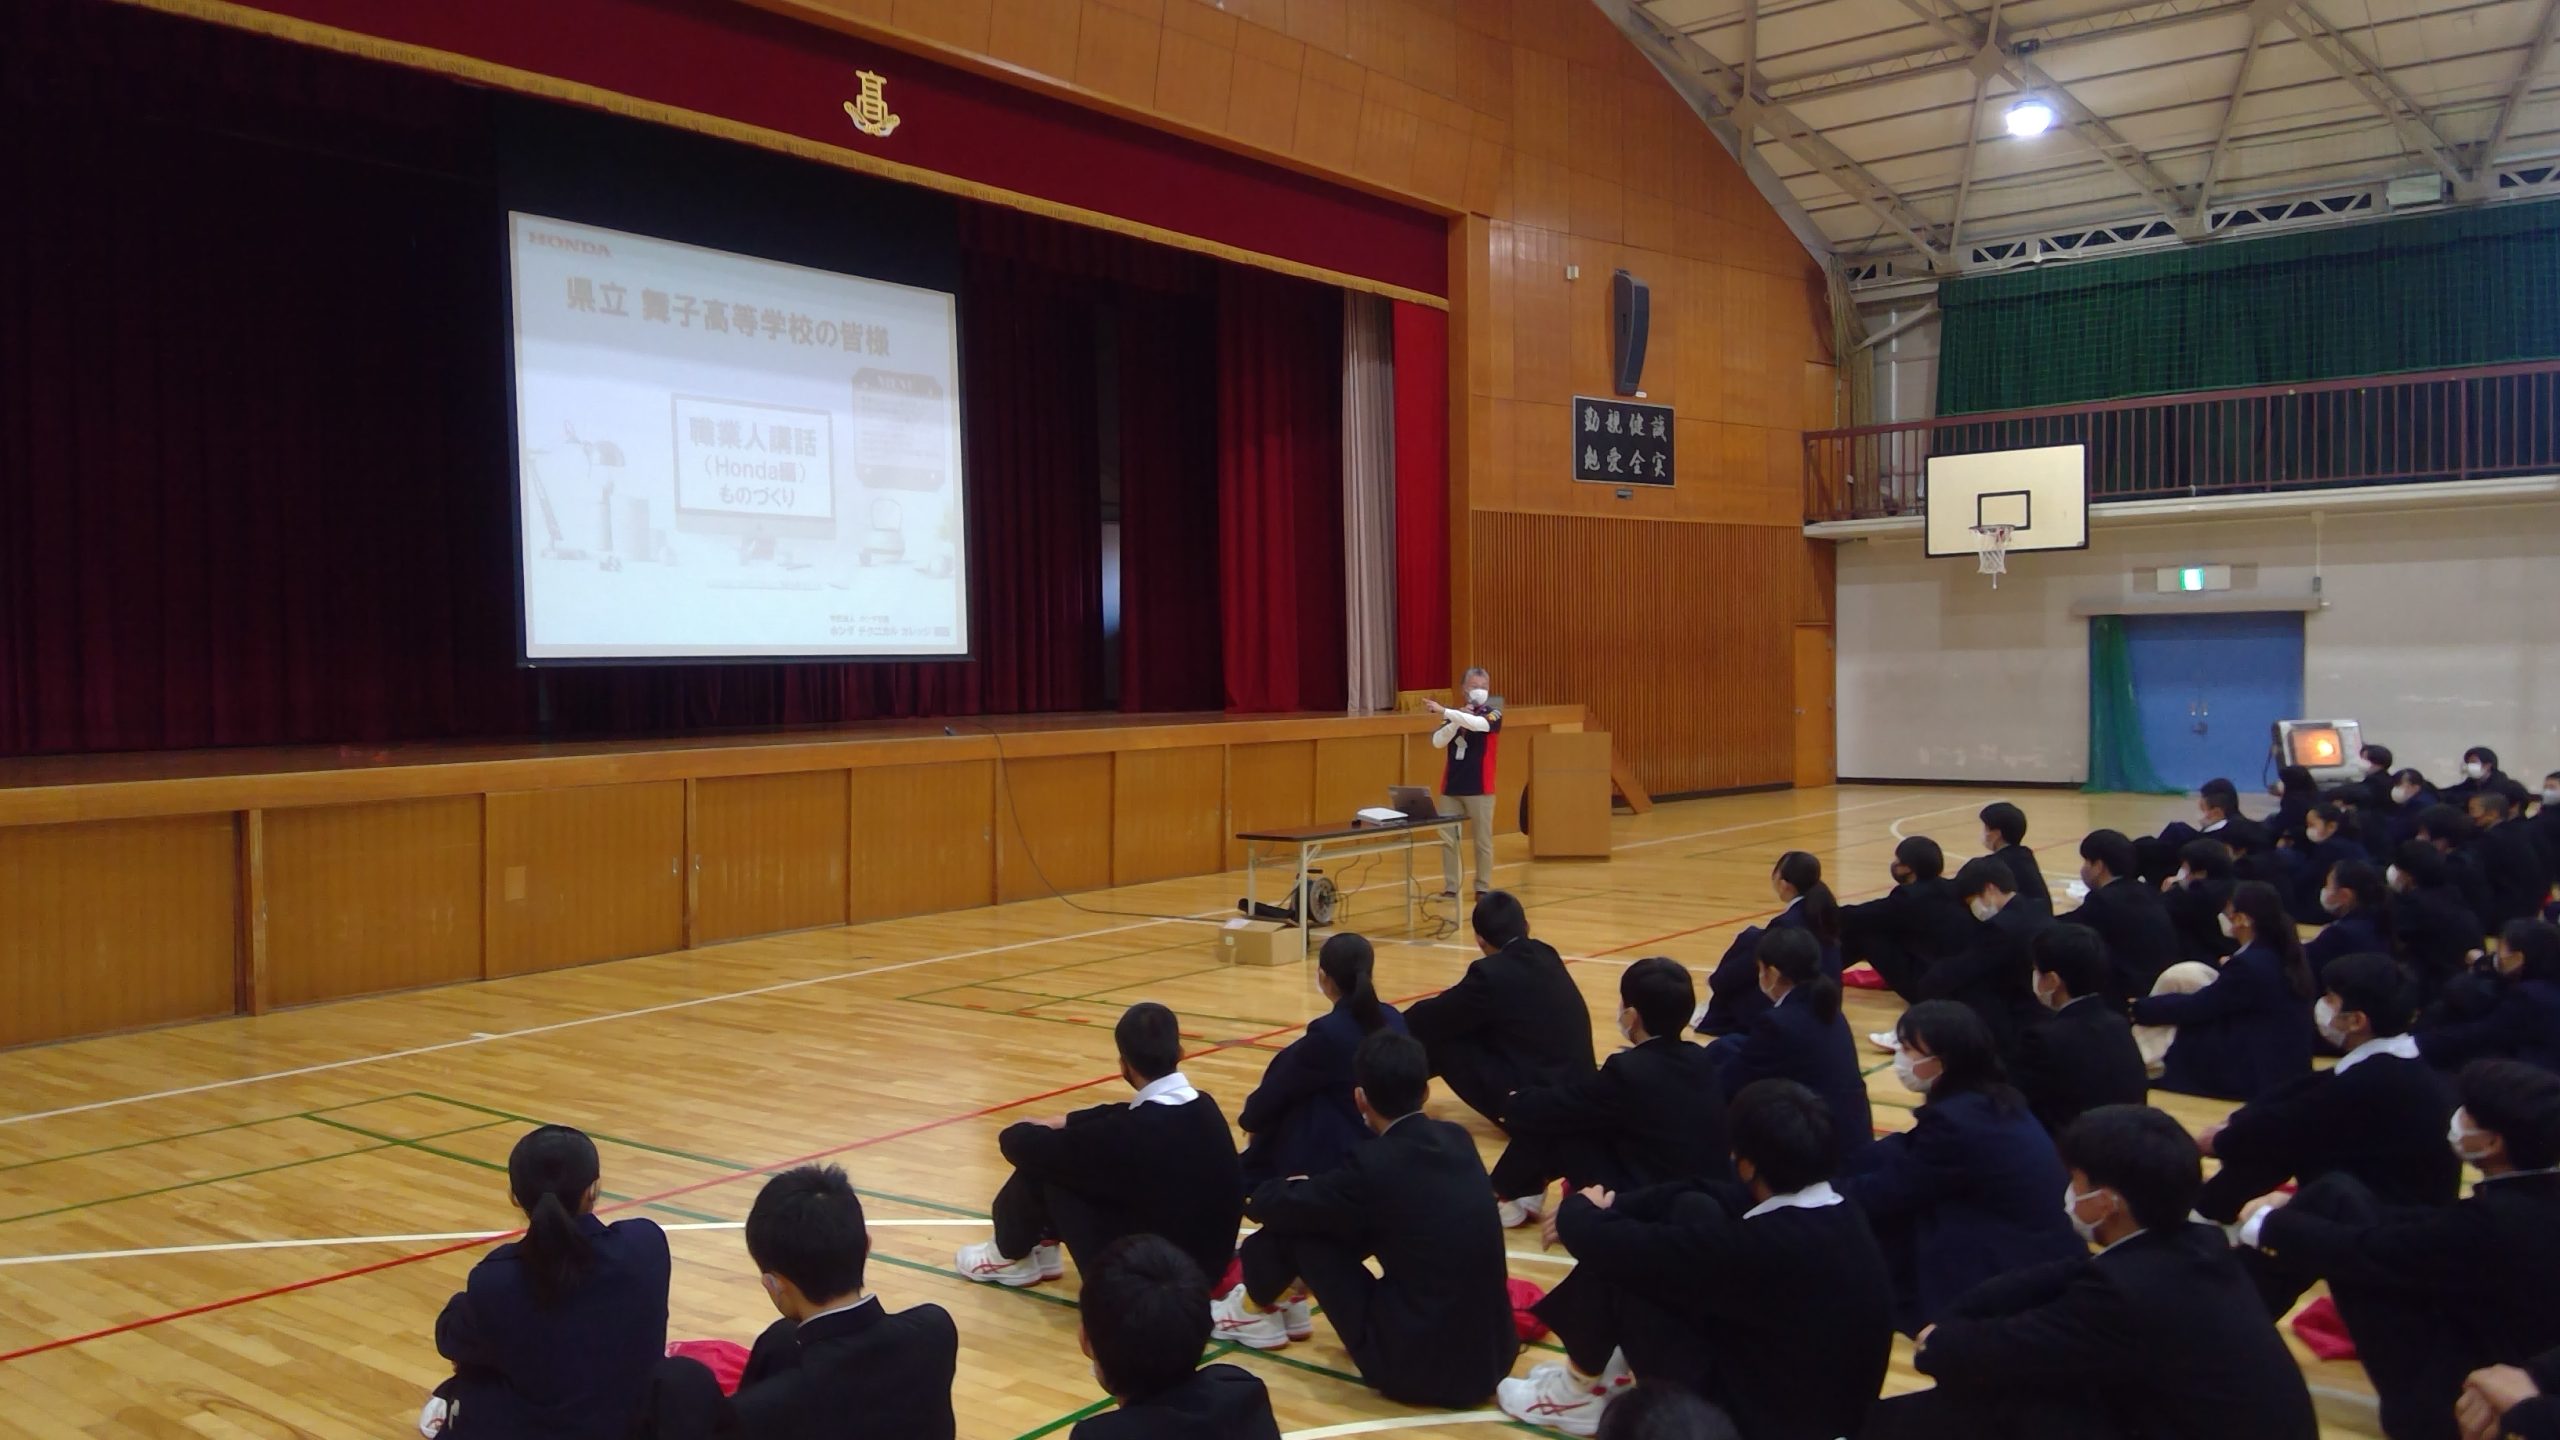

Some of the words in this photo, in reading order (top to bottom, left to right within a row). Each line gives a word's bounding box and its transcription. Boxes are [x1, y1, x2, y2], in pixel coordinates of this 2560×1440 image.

[528, 231, 612, 258] HONDA
[566, 276, 629, 318] 県立
[719, 483, 796, 508] ものづくり
